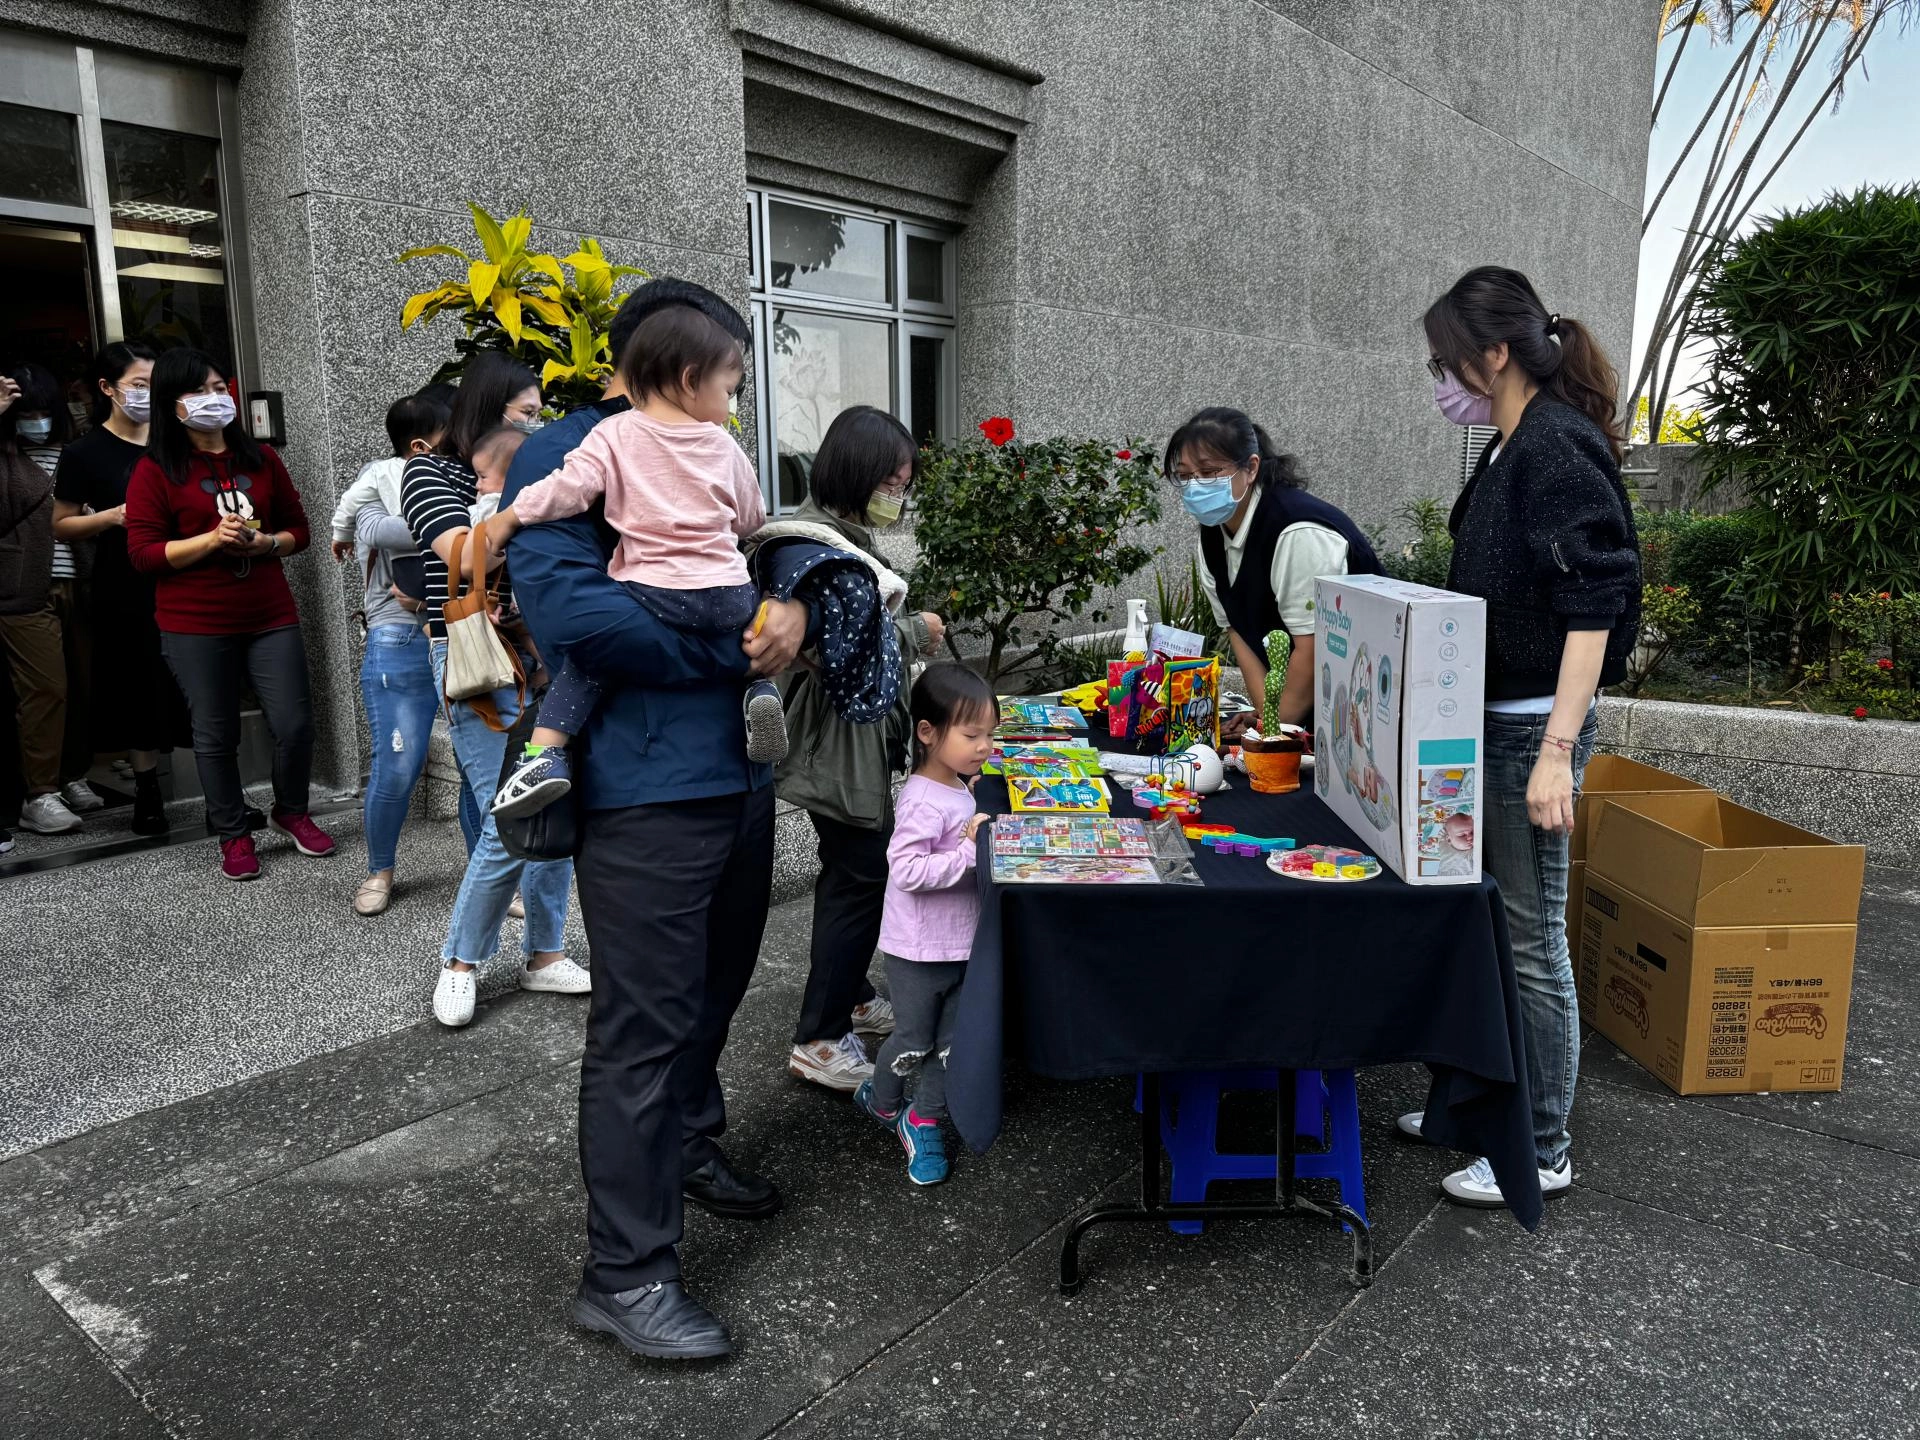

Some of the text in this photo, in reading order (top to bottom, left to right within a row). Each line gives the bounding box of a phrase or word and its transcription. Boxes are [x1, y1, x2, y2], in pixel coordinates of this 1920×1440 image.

[1712, 1001, 1751, 1010] 128280
[1755, 1014, 1827, 1040] MamyPoko
[1711, 1035, 1747, 1045] 每包66片
[1709, 1046, 1746, 1055] 3123036
[1707, 1068, 1743, 1077] 12828
